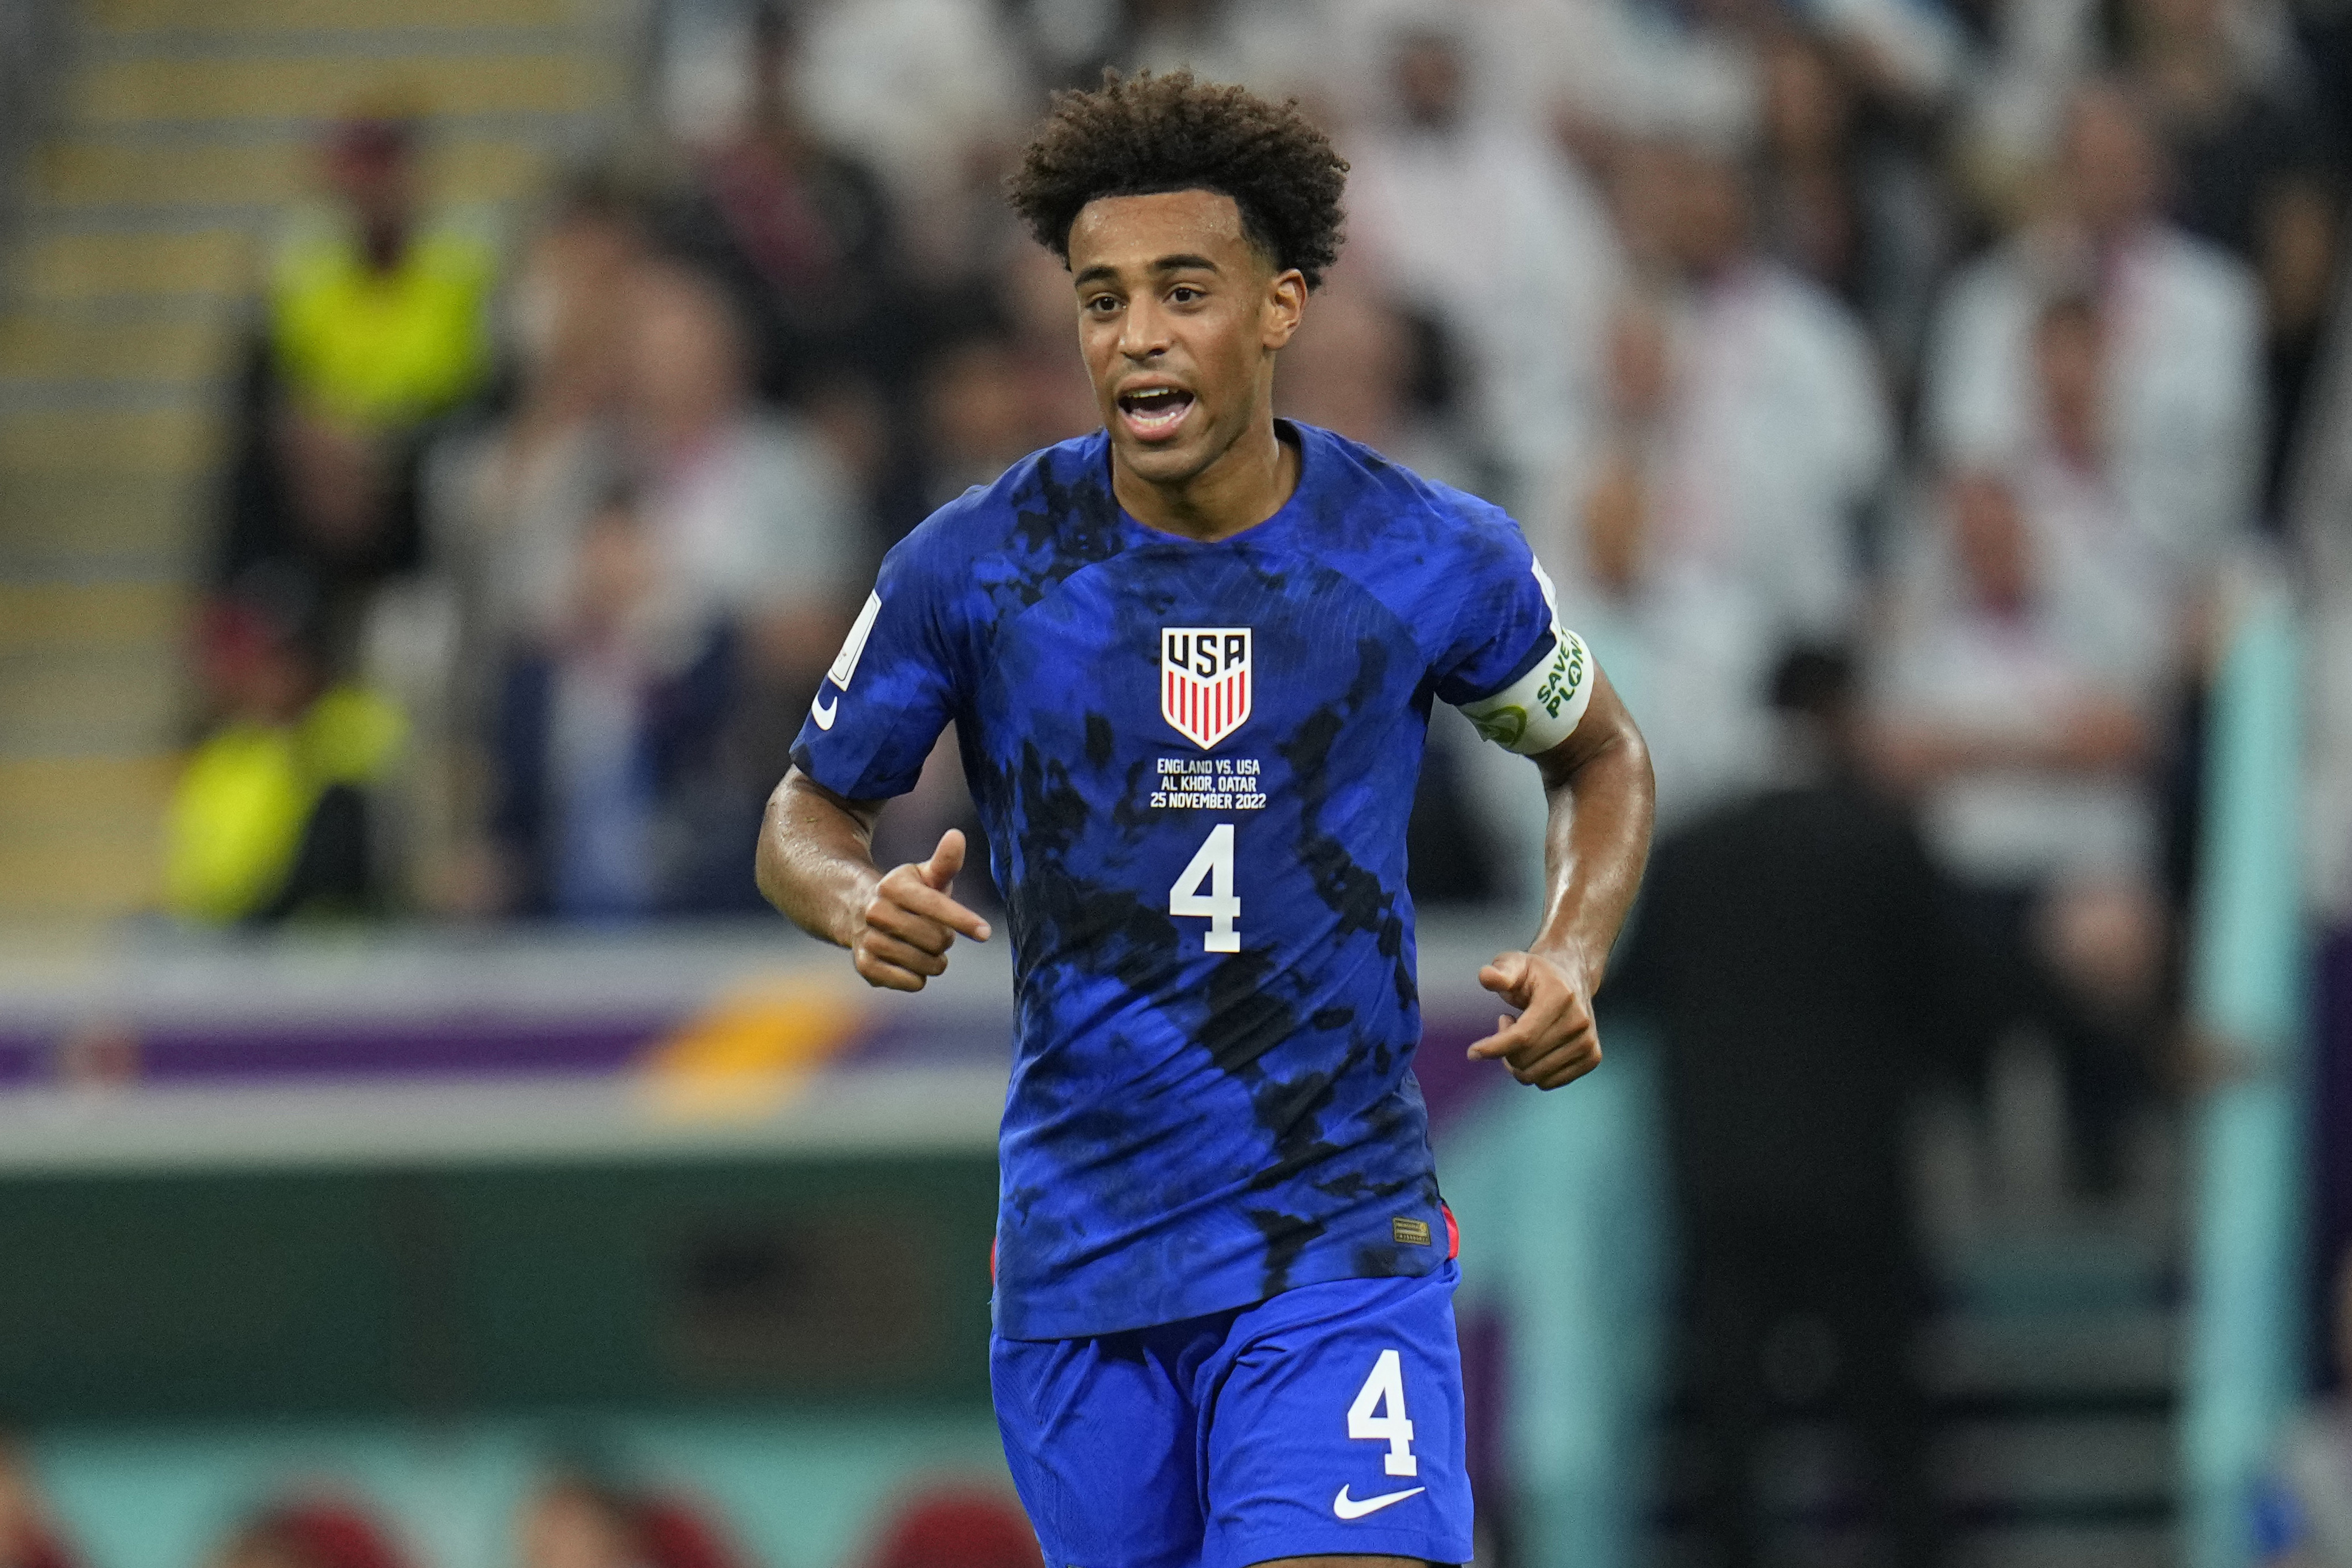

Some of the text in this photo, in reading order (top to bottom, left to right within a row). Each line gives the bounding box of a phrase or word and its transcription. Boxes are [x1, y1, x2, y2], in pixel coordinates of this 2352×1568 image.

[1168, 634, 1245, 679] USA
[1537, 641, 1570, 704] SAVE
[1546, 633, 1583, 719] PLAN
[1157, 758, 1260, 775] ENGLAND VS. USA
[1161, 775, 1257, 793] AL KHOR, QATAR
[1150, 792, 1267, 810] 25 NOVEMBER 2022
[1169, 823, 1241, 952] 4
[1347, 1349, 1417, 1476] 4
